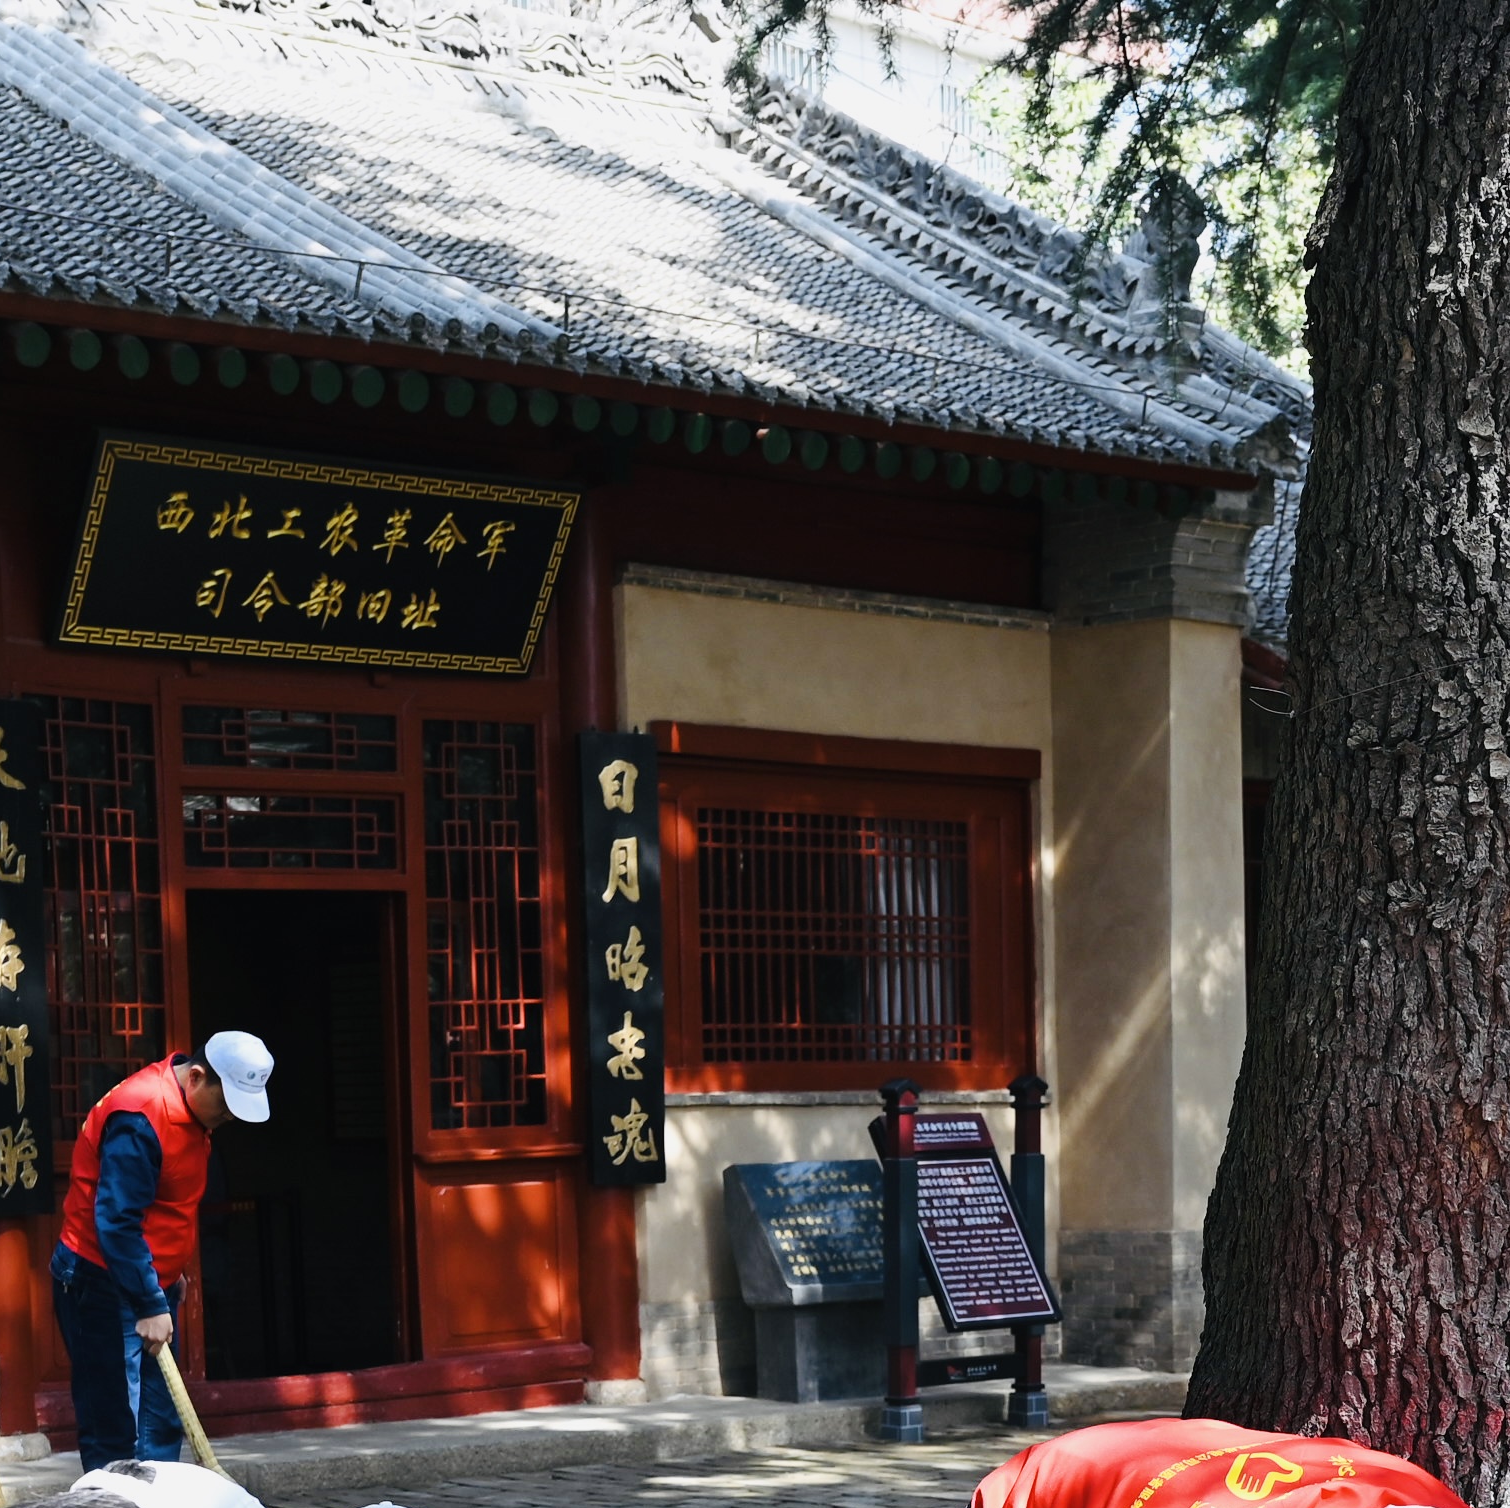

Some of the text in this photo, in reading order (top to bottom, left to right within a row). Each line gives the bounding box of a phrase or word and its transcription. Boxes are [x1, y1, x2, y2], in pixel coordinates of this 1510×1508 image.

[156, 491, 516, 571] 西北工农革命军
[195, 567, 441, 630] 司令部旧址
[598, 759, 659, 1166] 日月昭忠魂
